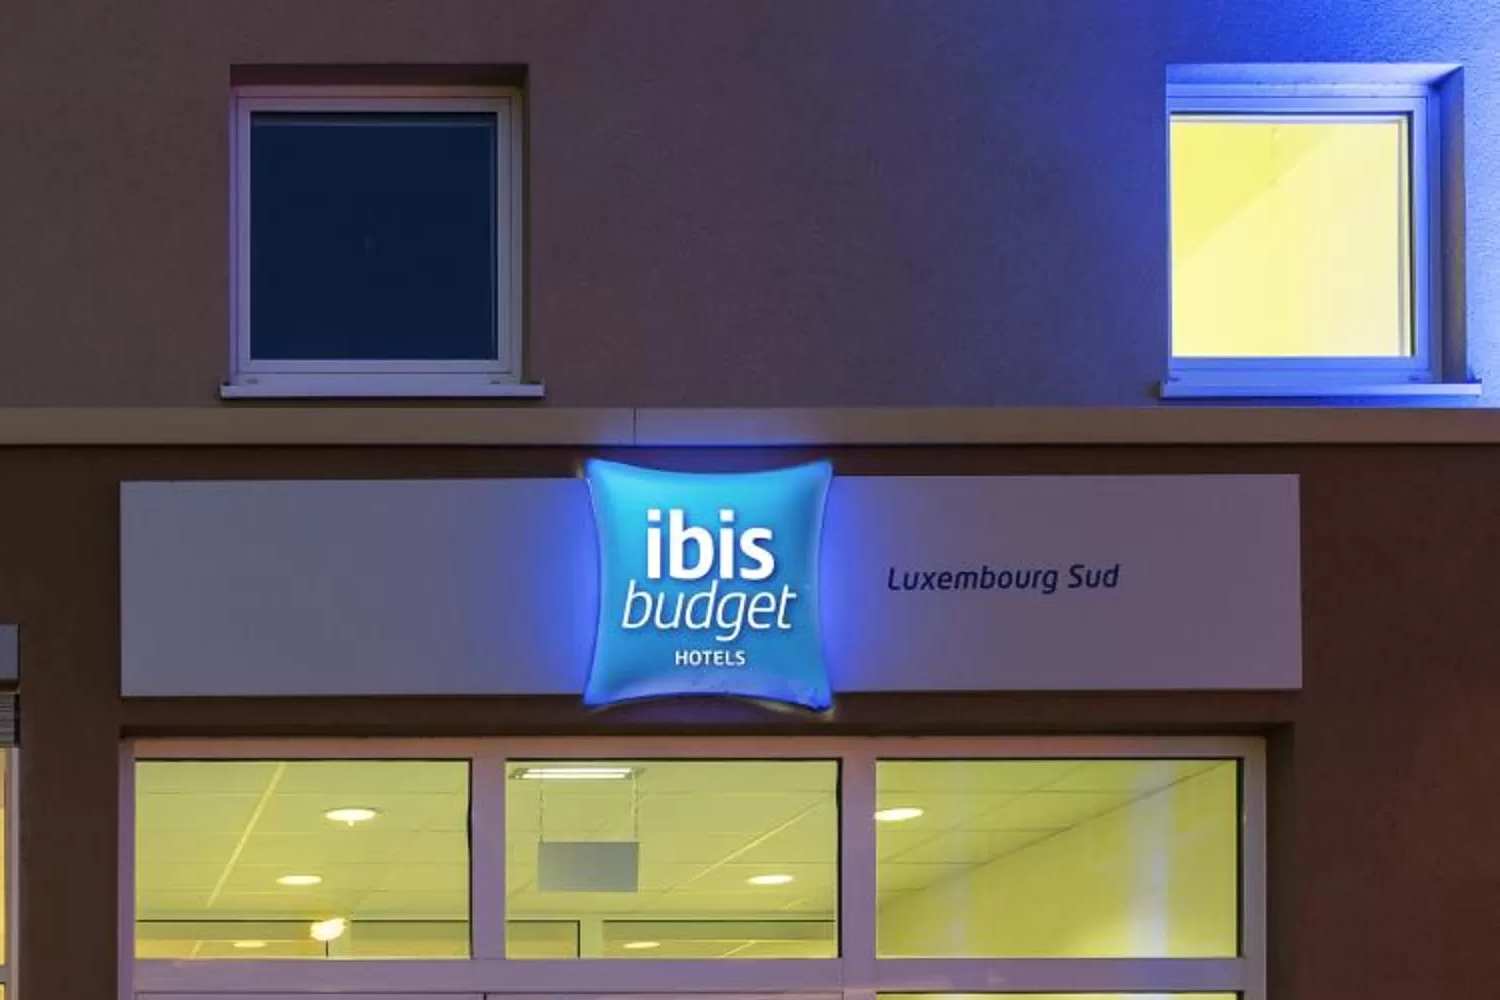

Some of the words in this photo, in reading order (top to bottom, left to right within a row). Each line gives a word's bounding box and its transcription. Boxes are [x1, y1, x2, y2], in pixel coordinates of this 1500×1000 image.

[646, 509, 775, 581] ibis
[887, 566, 1059, 595] Luxembourg
[1067, 563, 1120, 589] Sud
[620, 580, 798, 642] budget
[674, 649, 747, 667] HOTELS
